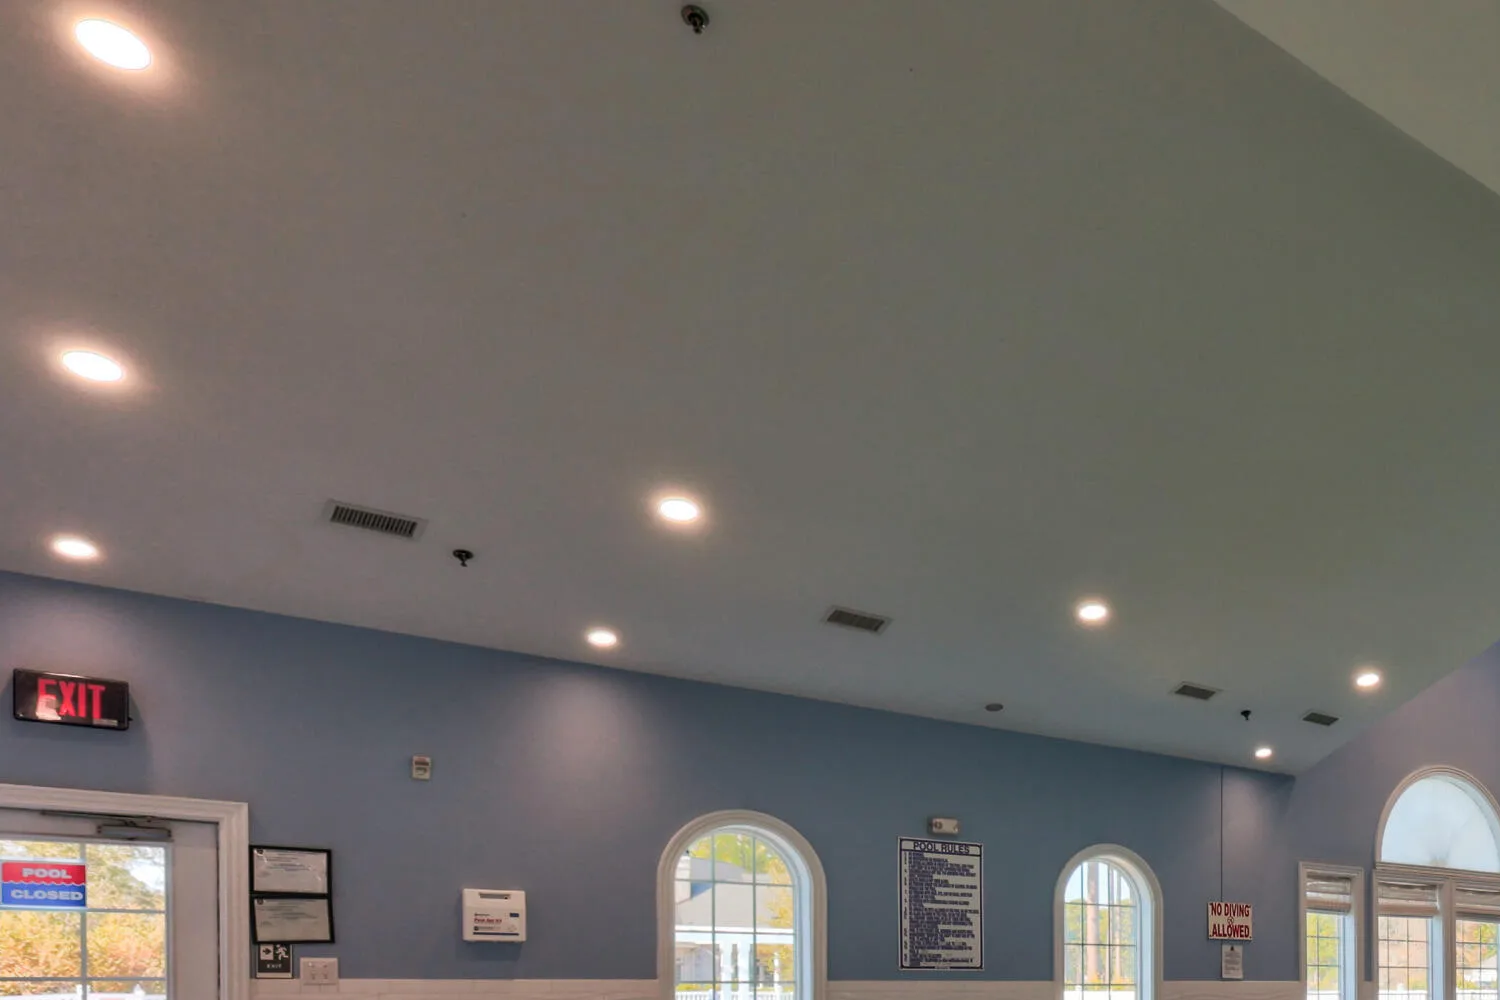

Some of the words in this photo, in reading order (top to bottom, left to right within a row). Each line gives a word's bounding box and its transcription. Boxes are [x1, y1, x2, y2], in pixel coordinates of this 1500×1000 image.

[36, 678, 106, 720] EXIT
[912, 841, 940, 853] POOL
[940, 843, 971, 854] RULES
[21, 867, 72, 879] POOL
[10, 889, 84, 900] CLOSED
[1209, 902, 1222, 916] NO
[1224, 903, 1251, 917] DIVING
[1212, 923, 1250, 938] ALLOWED
